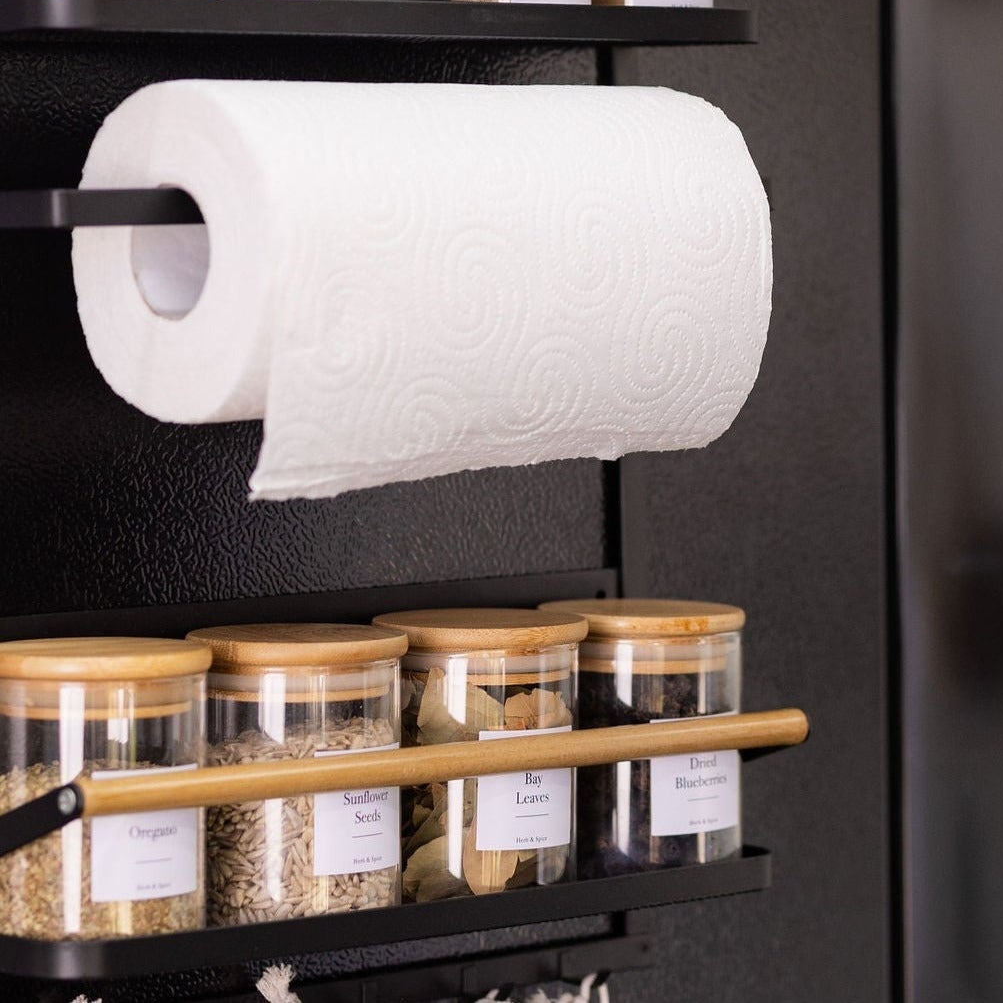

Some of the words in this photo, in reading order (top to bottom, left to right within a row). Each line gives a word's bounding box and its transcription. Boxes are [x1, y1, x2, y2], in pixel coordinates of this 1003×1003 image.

[690, 754, 717, 770] Dried
[525, 772, 543, 788] Bay
[675, 775, 728, 790] Blueberries
[343, 790, 389, 806] Sunflower
[516, 791, 549, 805] Leaves
[355, 808, 382, 824] Seeds
[128, 825, 178, 842] Oregano
